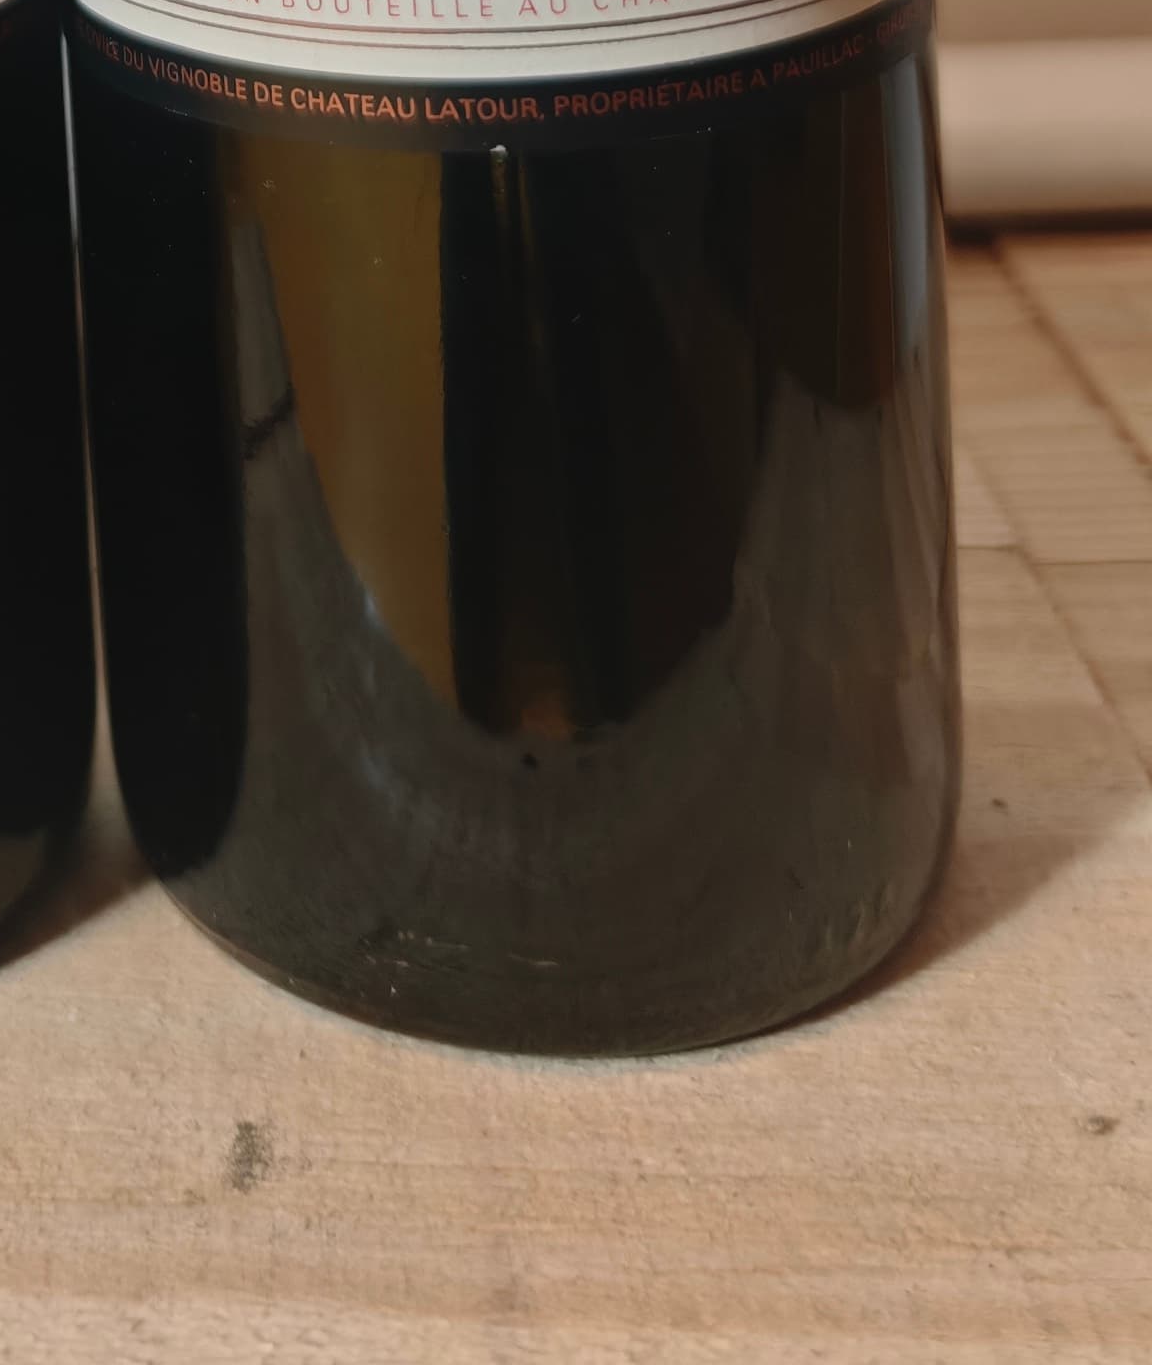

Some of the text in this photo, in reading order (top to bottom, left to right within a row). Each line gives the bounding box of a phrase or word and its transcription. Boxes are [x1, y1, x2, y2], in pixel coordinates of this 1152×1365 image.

[123, 45, 144, 72] DU
[148, 56, 248, 100] VIGNOBLE
[254, 81, 283, 106] DE
[290, 87, 416, 119] CHATEAU
[425, 97, 545, 122] LATOUR,
[554, 72, 744, 117] PROPRIÉTAIRE
[773, 34, 865, 83] PAUILLAC
